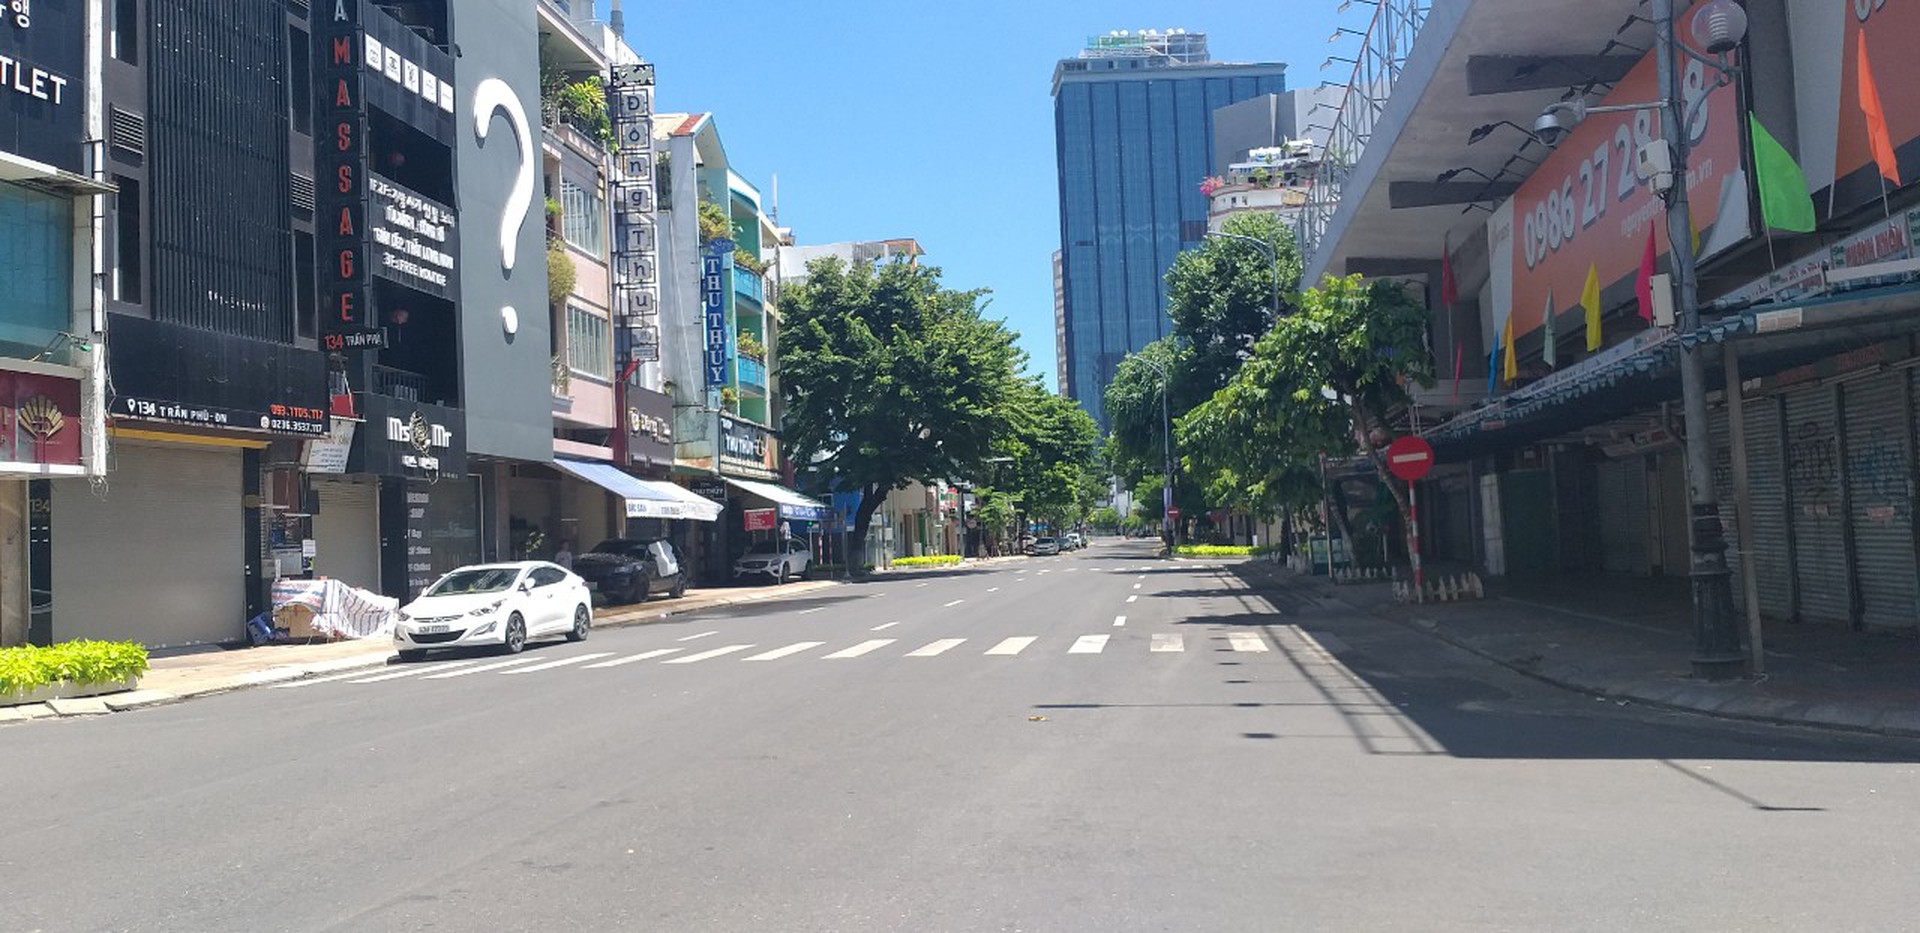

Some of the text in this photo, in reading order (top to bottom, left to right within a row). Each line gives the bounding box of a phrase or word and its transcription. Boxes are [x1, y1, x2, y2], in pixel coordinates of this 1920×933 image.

[333, 36, 353, 321] MASSAGE
[626, 95, 649, 307] Đông Thu
[1524, 176, 1576, 269] 0986
[1579, 140, 1609, 231] 27
[707, 258, 722, 308] THU
[324, 334, 345, 350] 134
[138, 401, 156, 416] 134
[430, 423, 452, 448] Mr
